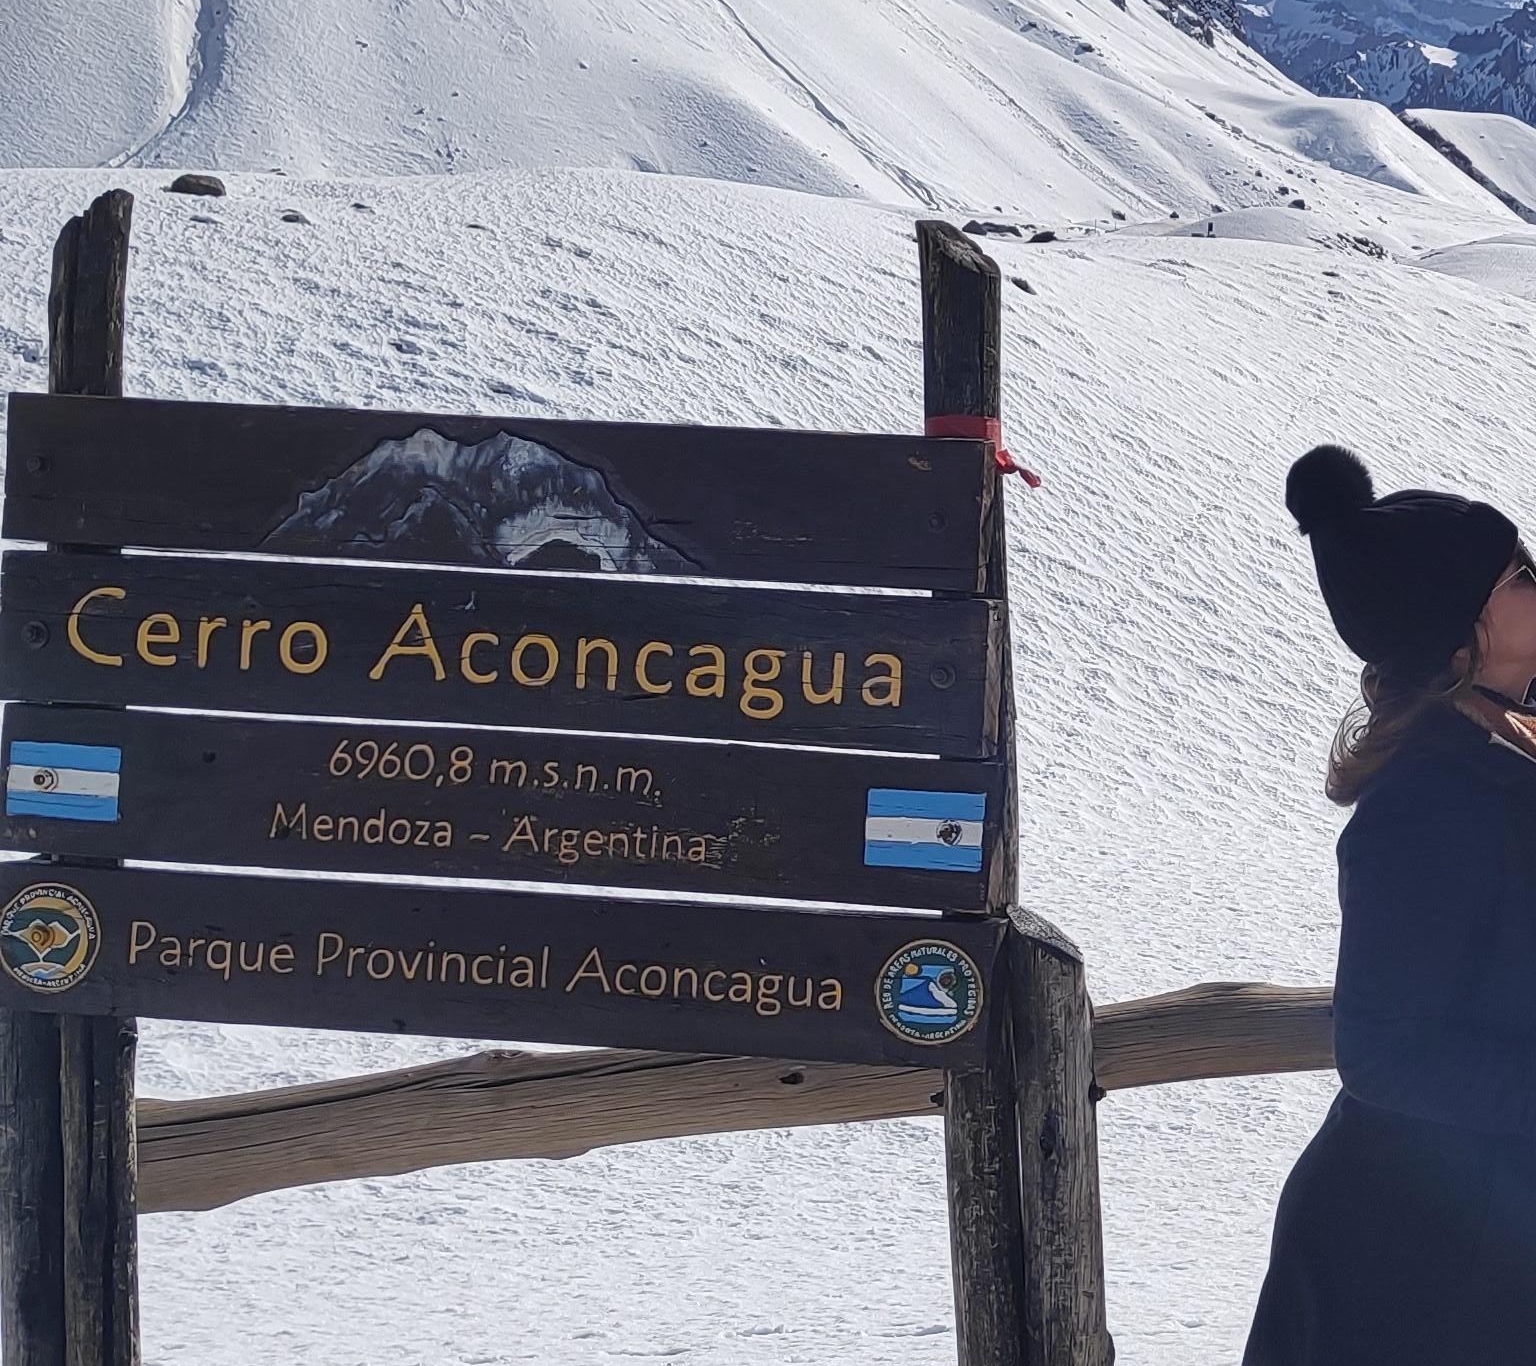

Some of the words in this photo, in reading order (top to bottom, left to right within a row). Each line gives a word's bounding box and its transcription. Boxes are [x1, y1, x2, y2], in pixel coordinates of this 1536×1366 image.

[67, 586, 329, 674] Cerro
[368, 603, 903, 720] Aconcagua
[328, 739, 474, 787] 6960,8
[488, 757, 662, 797] m.s.n.m.
[269, 802, 453, 848] Mendoza
[502, 815, 707, 864] Argentina
[128, 920, 296, 981] Parque
[316, 932, 550, 989] Provincial
[565, 946, 843, 1016] Aconcagua
[883, 977, 894, 990] DE
[910, 946, 958, 962] NATURALES
